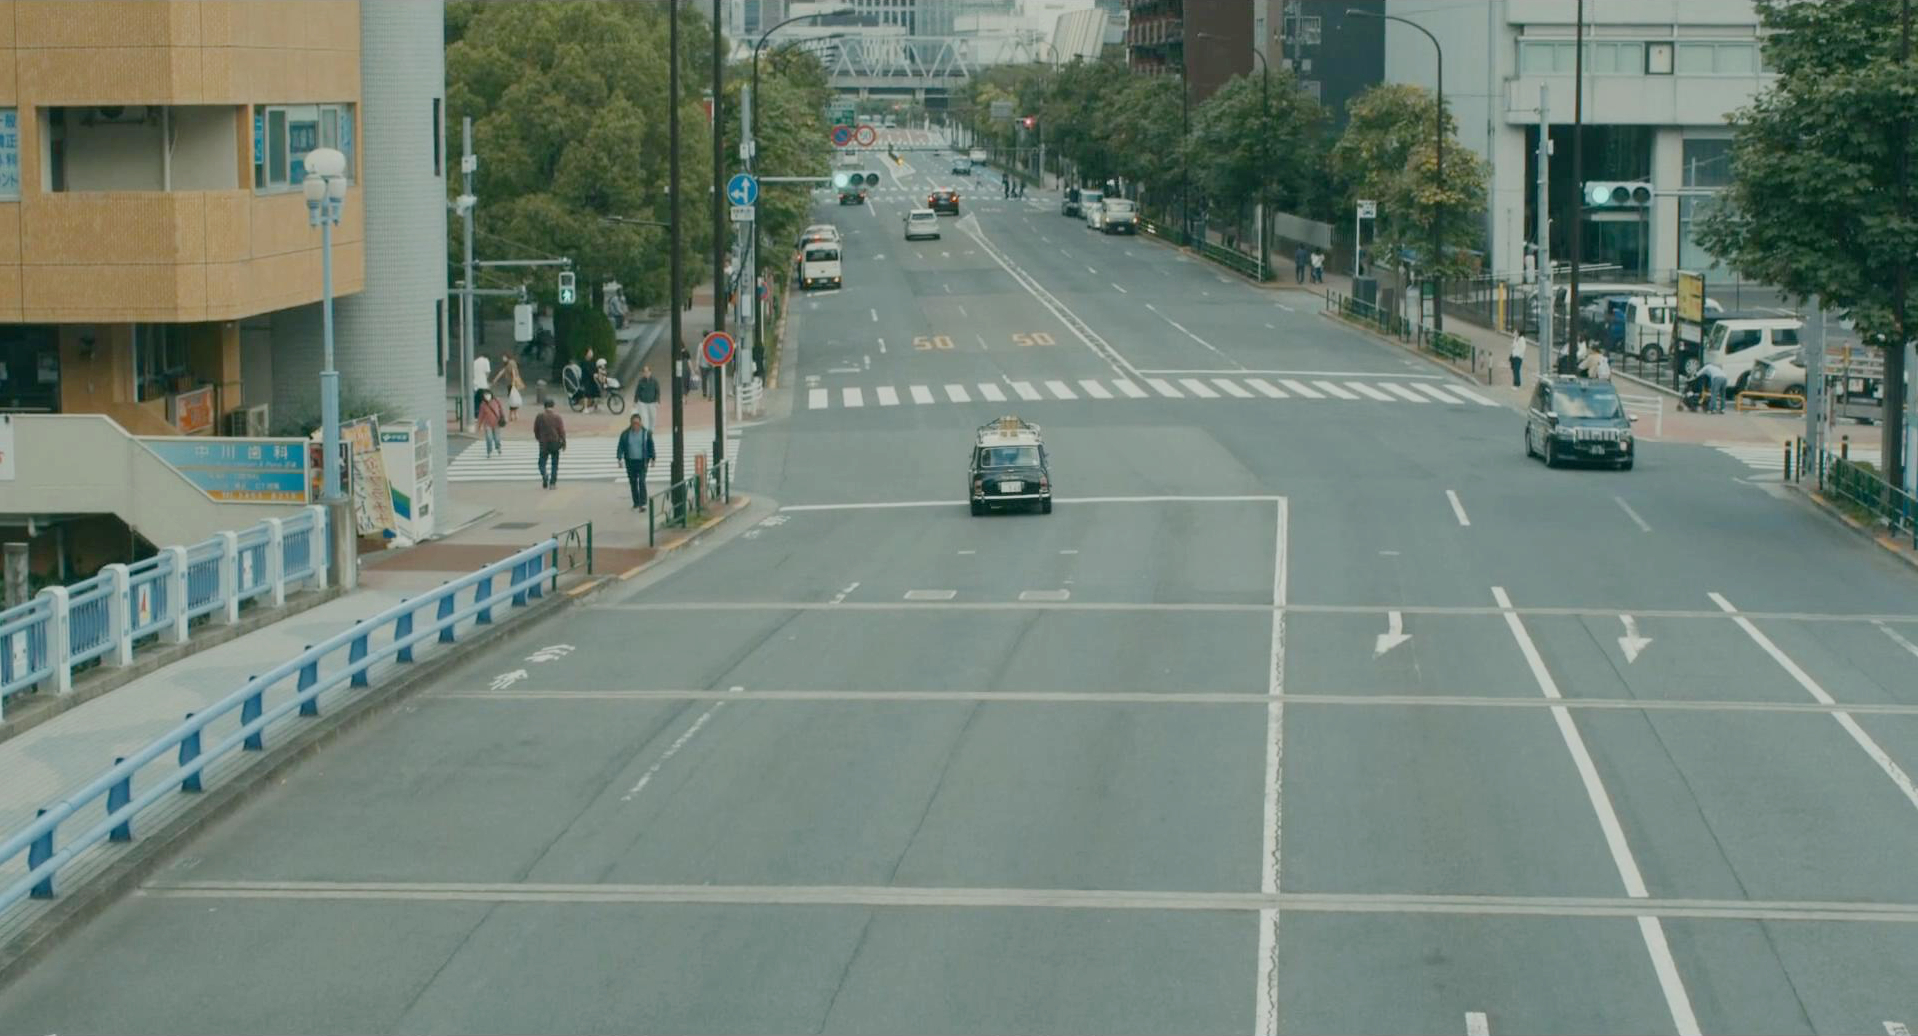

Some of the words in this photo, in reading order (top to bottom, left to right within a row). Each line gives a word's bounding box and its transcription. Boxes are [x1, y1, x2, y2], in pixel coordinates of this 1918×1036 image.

[912, 335, 955, 350] 50
[1012, 332, 1056, 347] 50
[194, 445, 288, 460] 中川歯科
